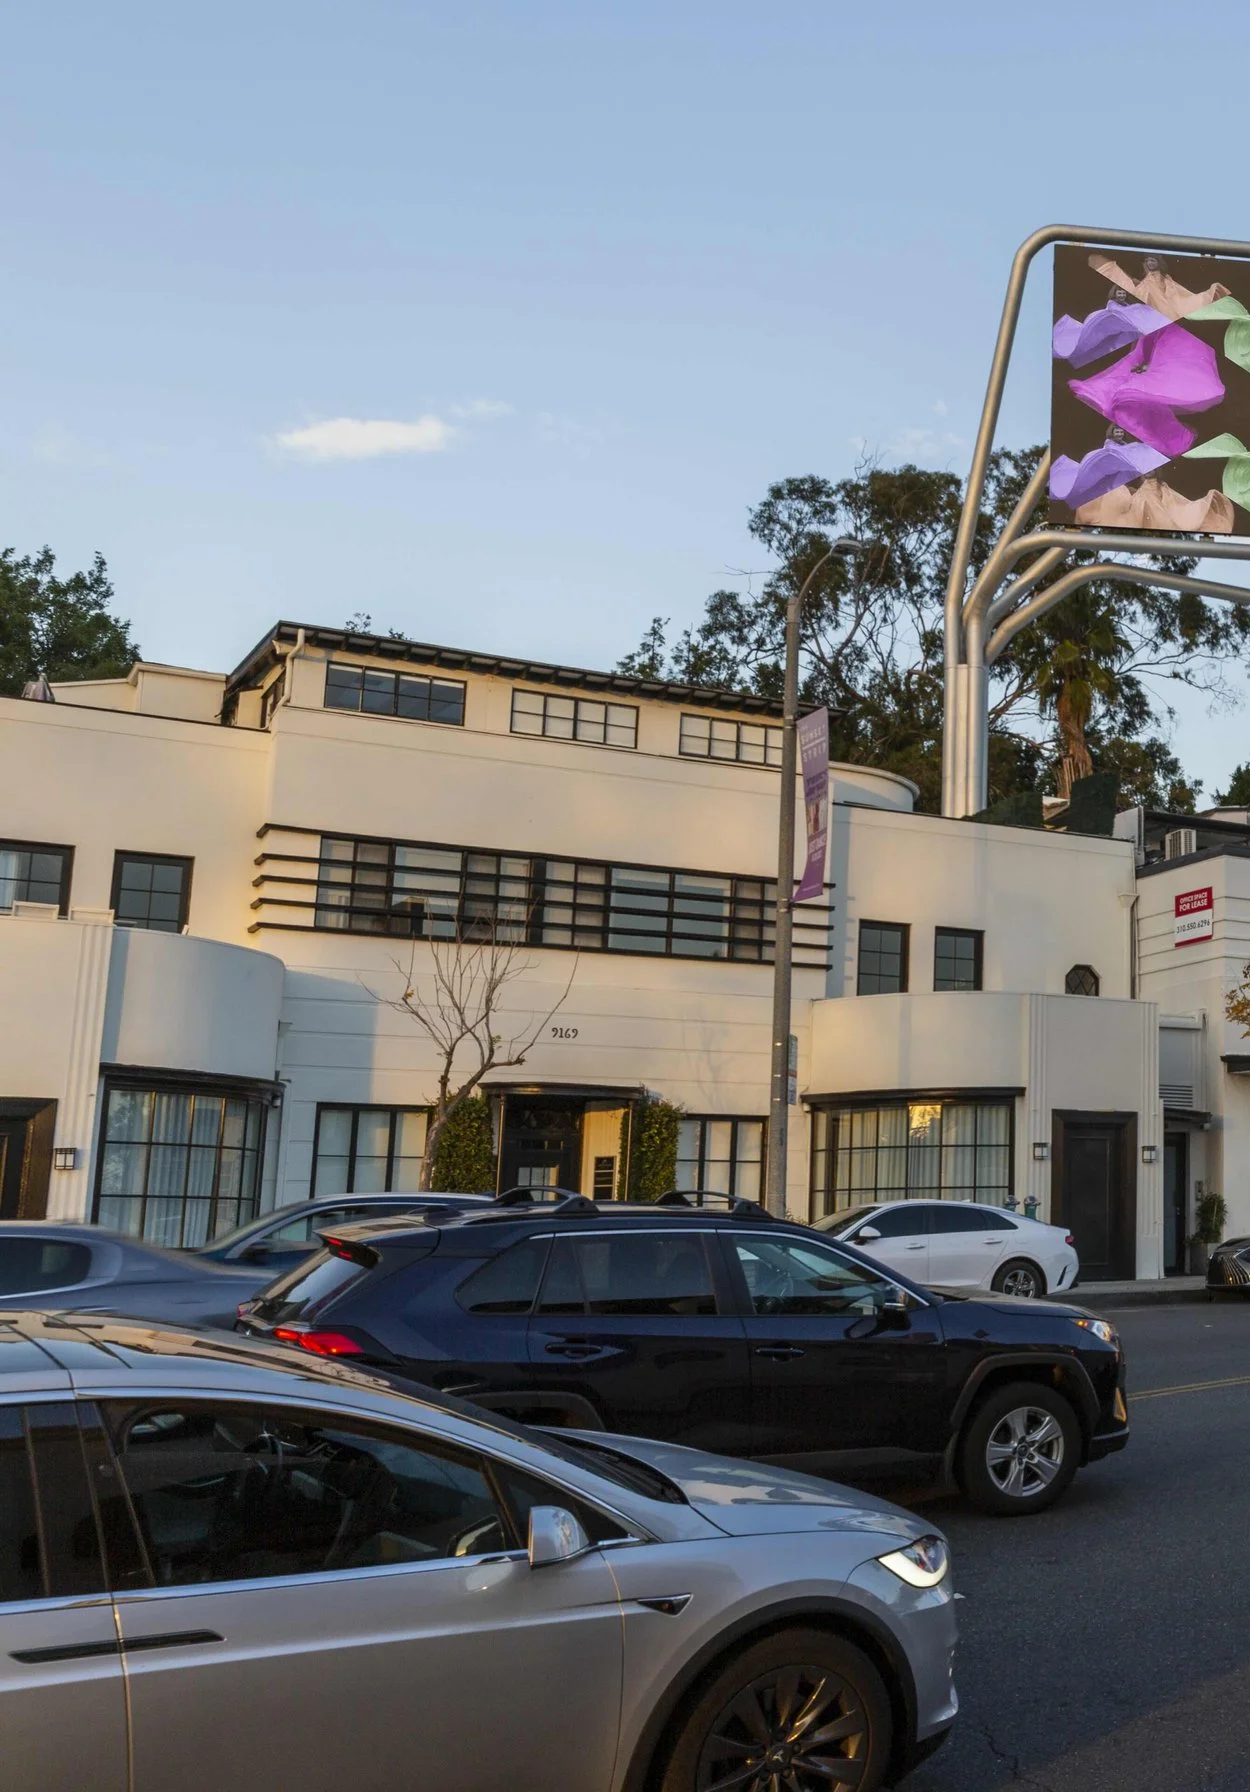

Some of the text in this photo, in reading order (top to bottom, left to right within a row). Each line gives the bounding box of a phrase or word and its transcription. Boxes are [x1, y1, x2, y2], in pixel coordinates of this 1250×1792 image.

[1179, 891, 1208, 904] OFFICE SPACE
[1179, 898, 1207, 912] FOR LEASE
[552, 1027, 579, 1039] 9169
